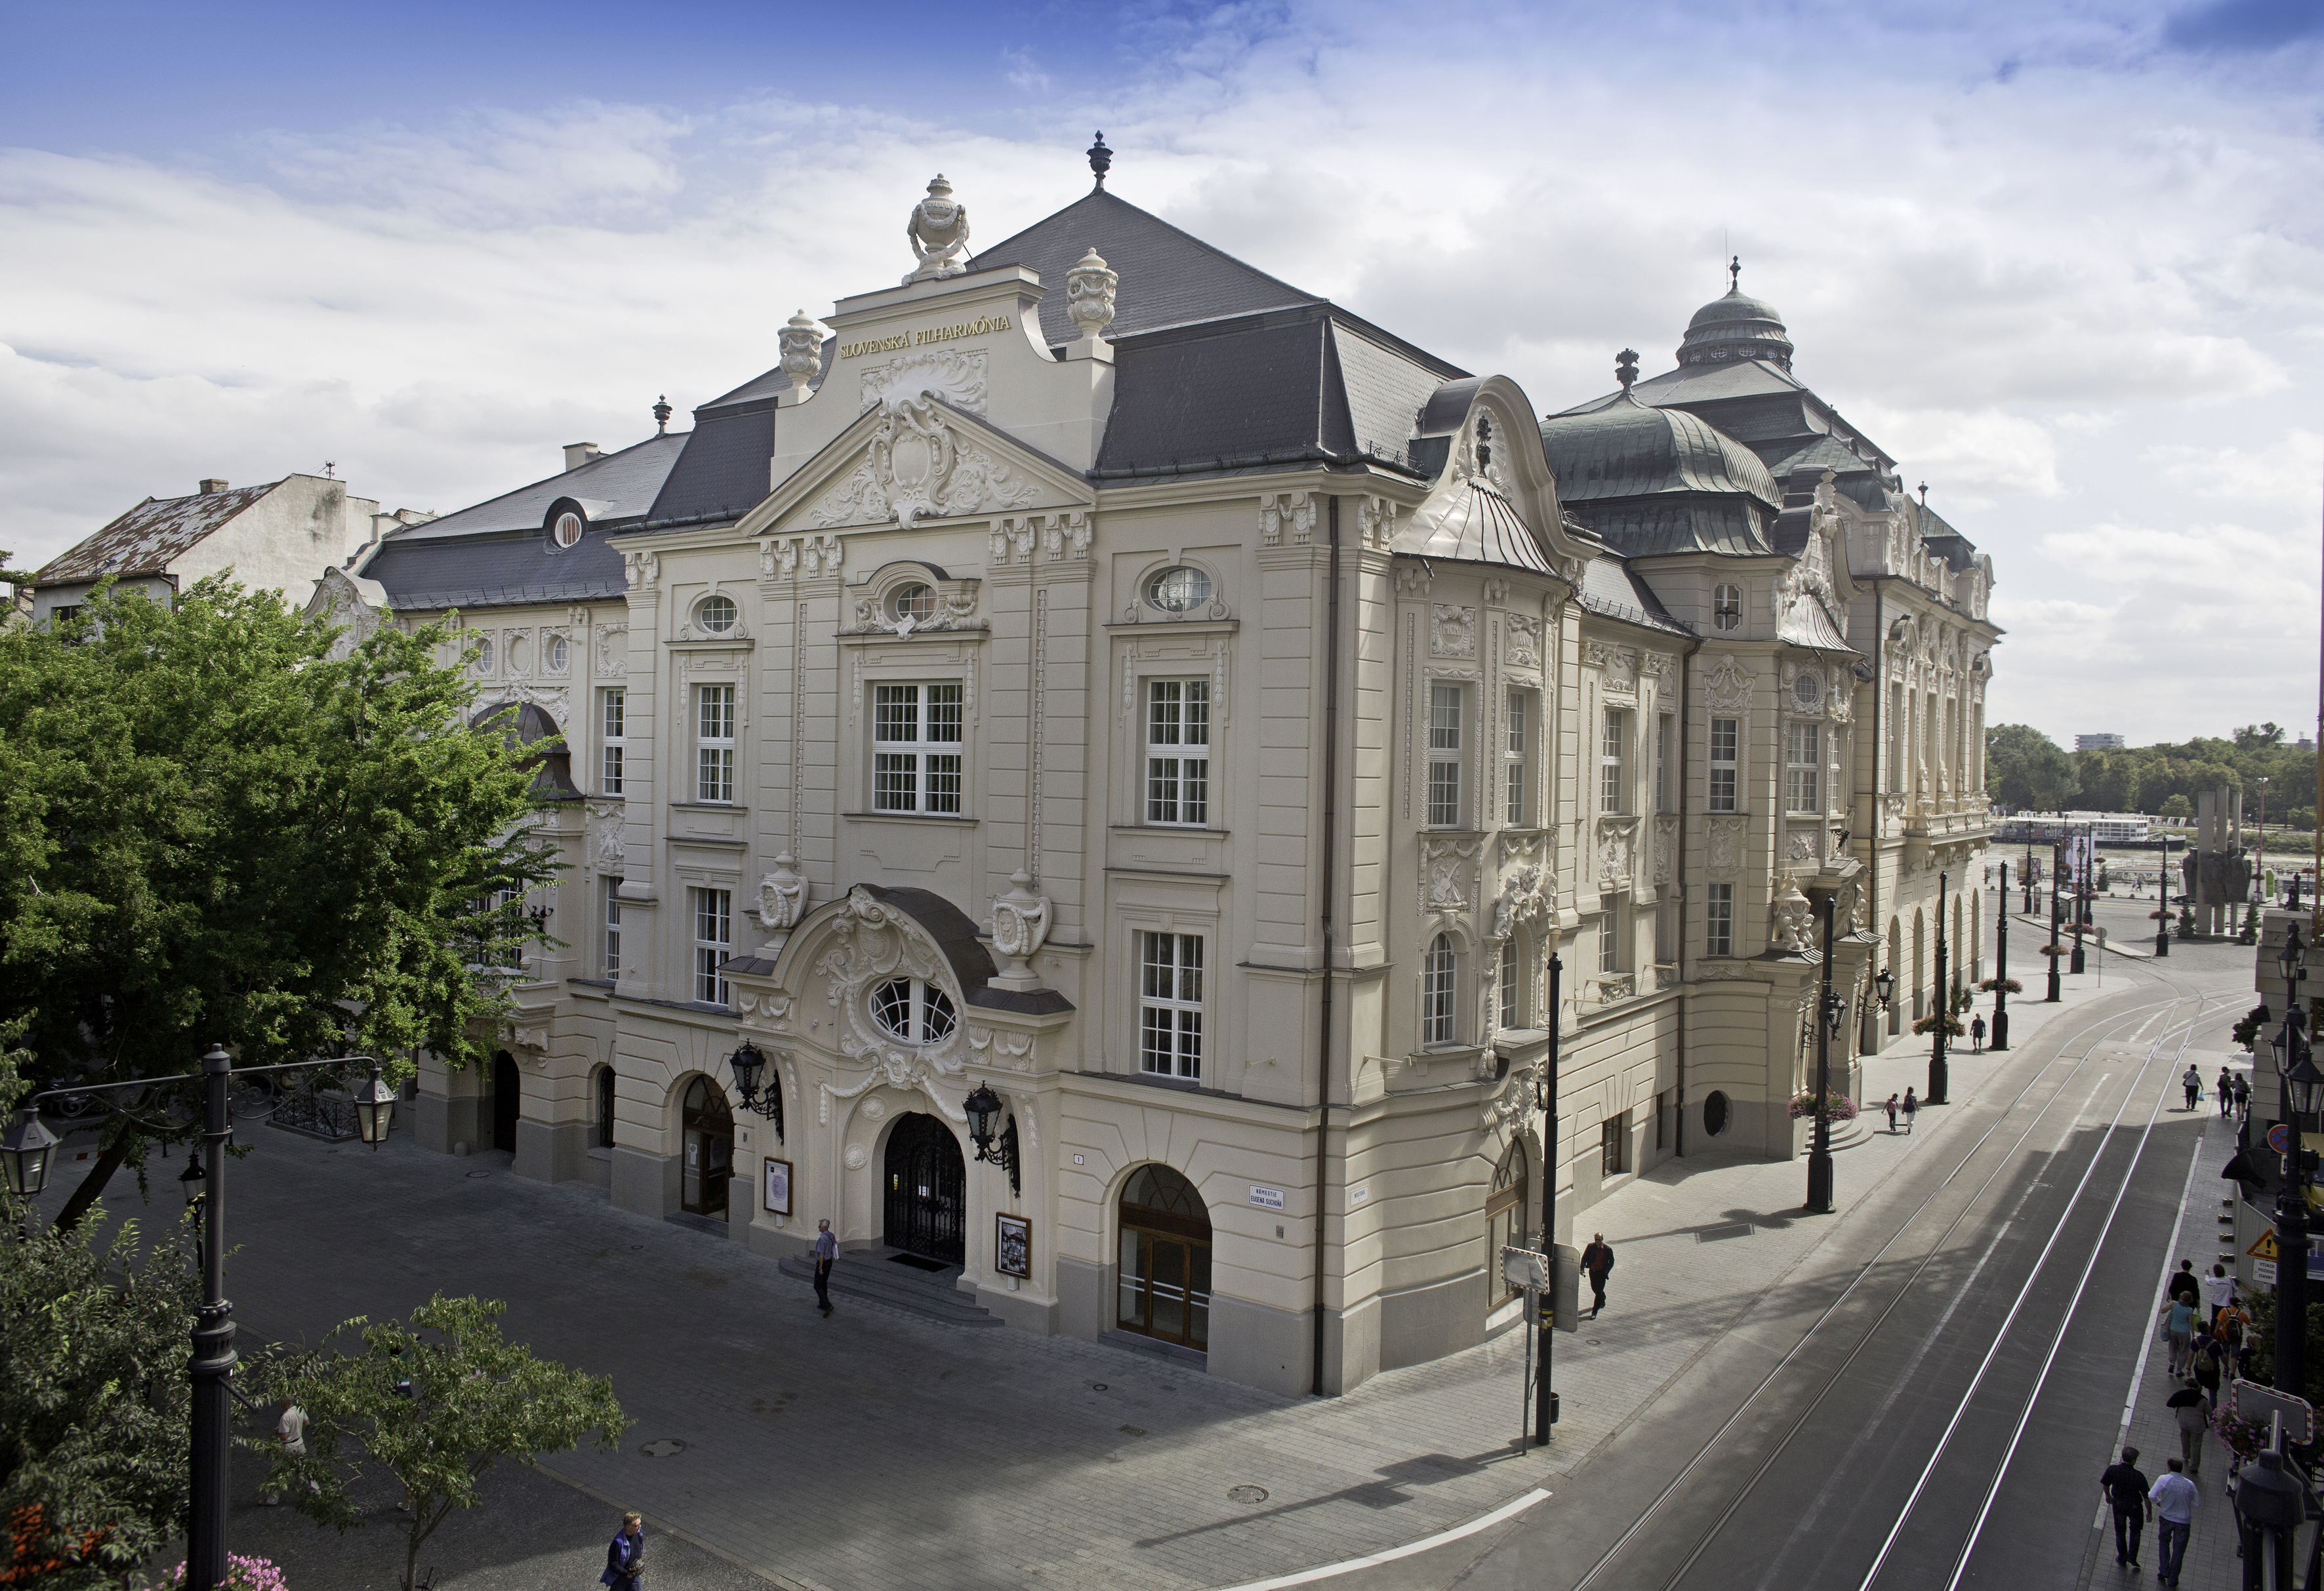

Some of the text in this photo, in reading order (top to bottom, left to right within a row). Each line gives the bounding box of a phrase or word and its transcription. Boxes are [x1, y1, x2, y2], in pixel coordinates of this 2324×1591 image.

[840, 315, 1010, 359] SLOVENSKÁ FILHARMÓNIA
[1256, 1188, 1277, 1198] NÁMESTIE
[1250, 1195, 1282, 1207] EUGENA SUCHOŇA
